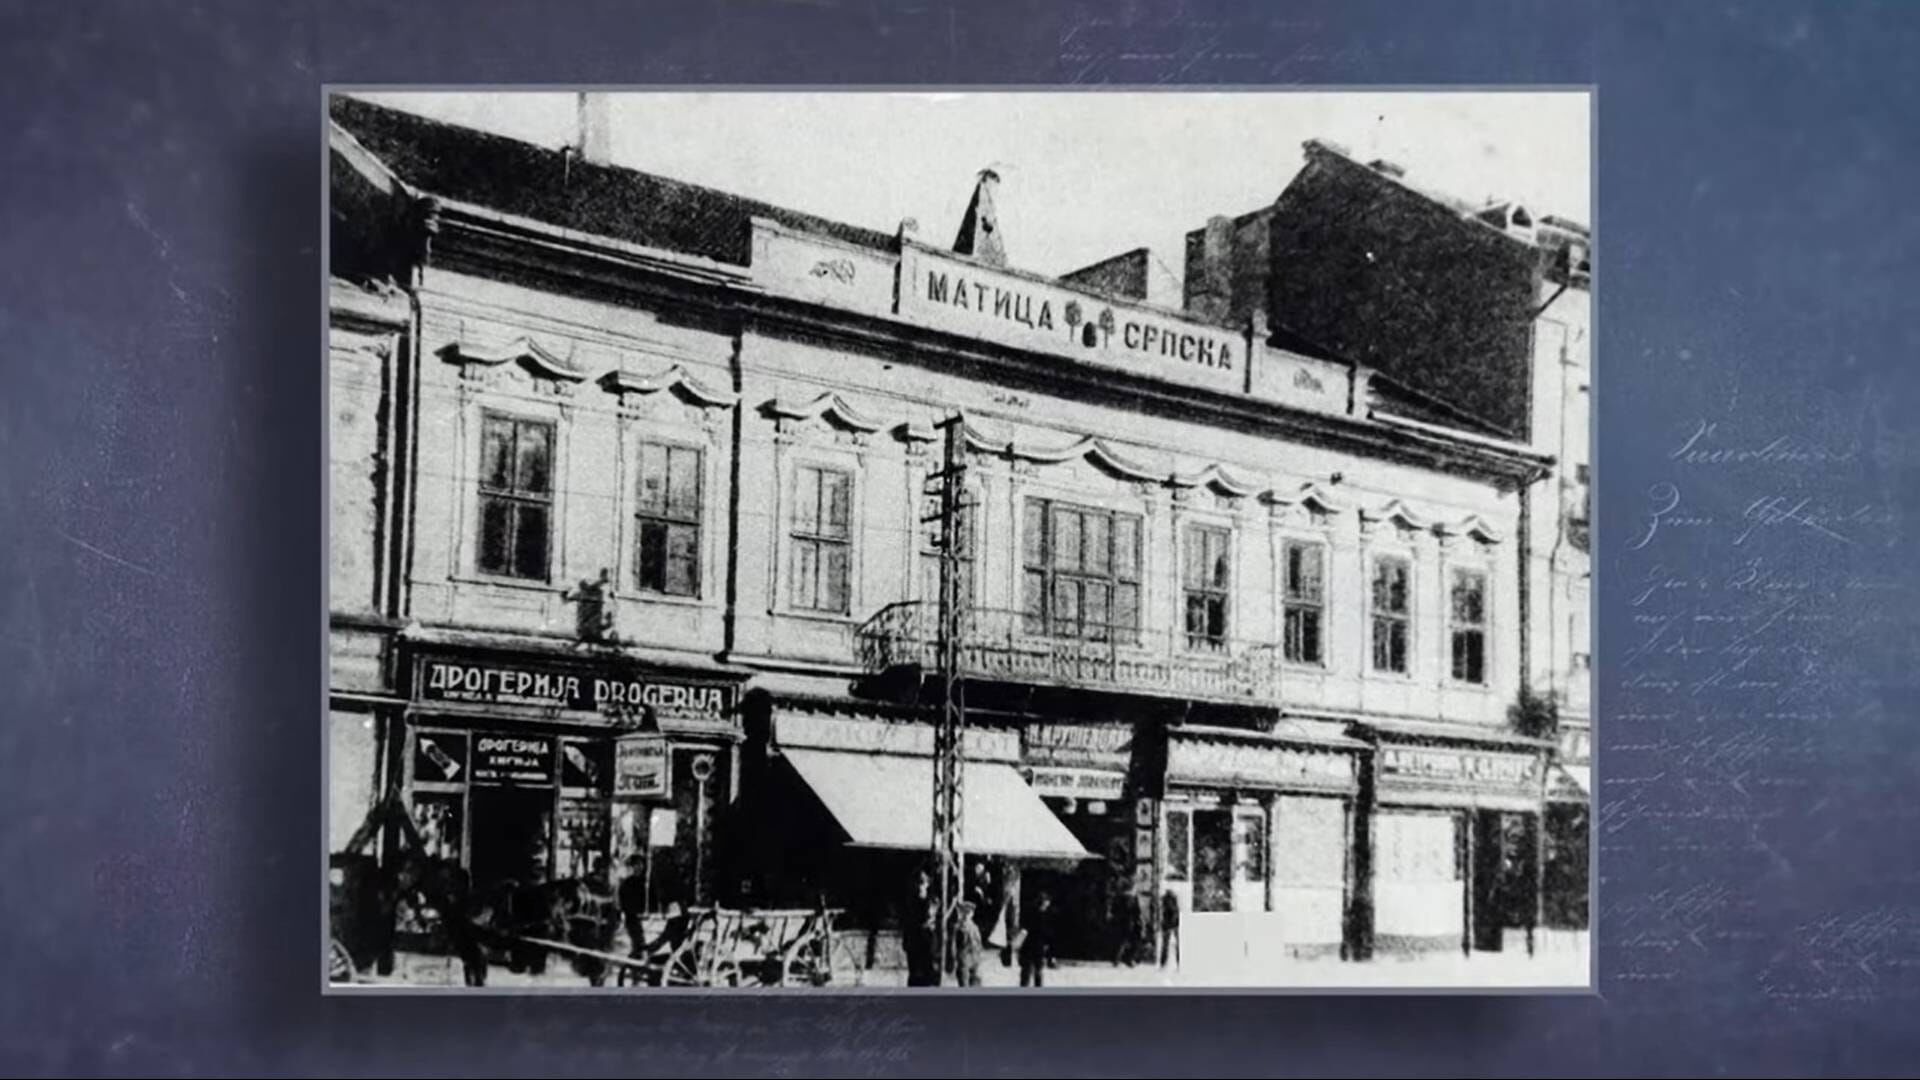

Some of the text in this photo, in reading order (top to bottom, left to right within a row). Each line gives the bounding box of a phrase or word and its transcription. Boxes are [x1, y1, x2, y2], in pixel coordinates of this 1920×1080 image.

[928, 271, 1232, 369] МАТИЦА СРПСКА
[430, 664, 580, 699] ДРОГЕРИЈА
[594, 679, 723, 711] DROGERIJA
